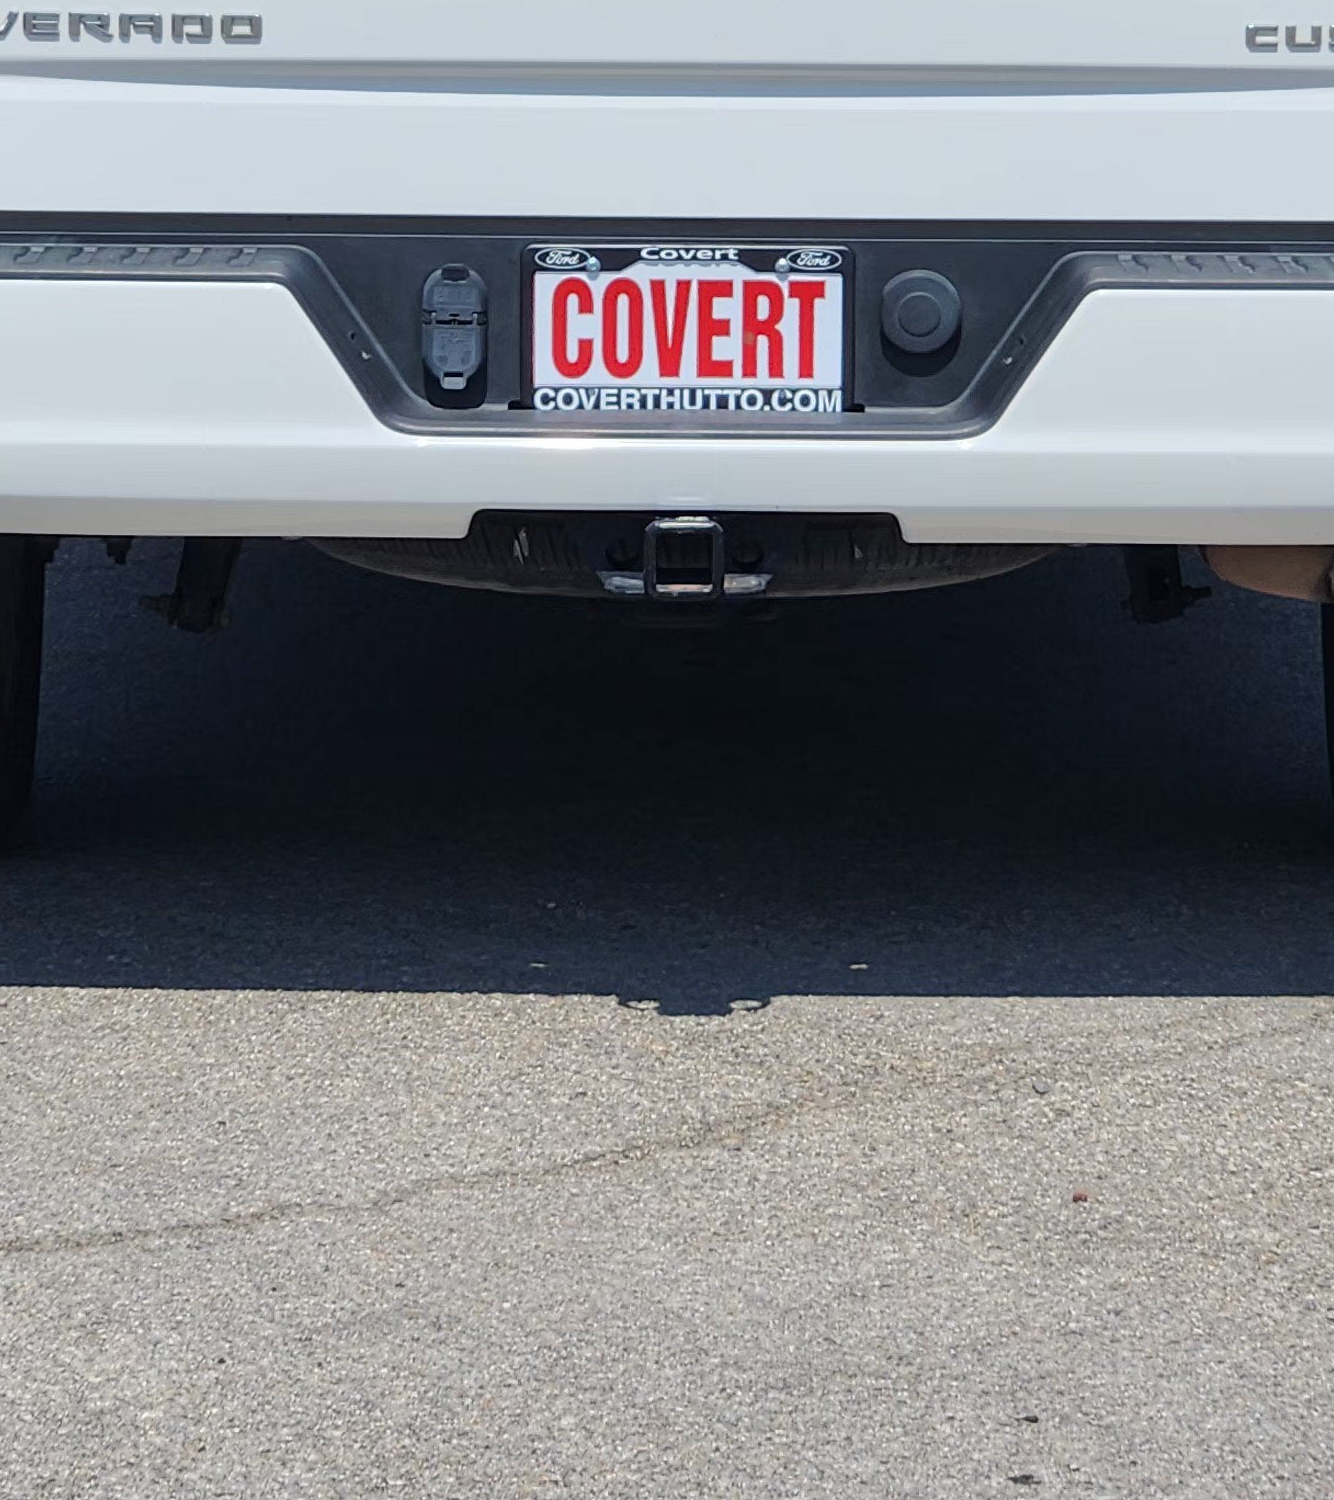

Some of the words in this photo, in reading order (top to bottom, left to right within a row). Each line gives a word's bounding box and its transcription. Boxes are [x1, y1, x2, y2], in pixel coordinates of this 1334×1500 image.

[640, 247, 739, 261] Covert
[551, 276, 826, 379] COVERT
[533, 387, 843, 413] COVERTHUTTO.COM
